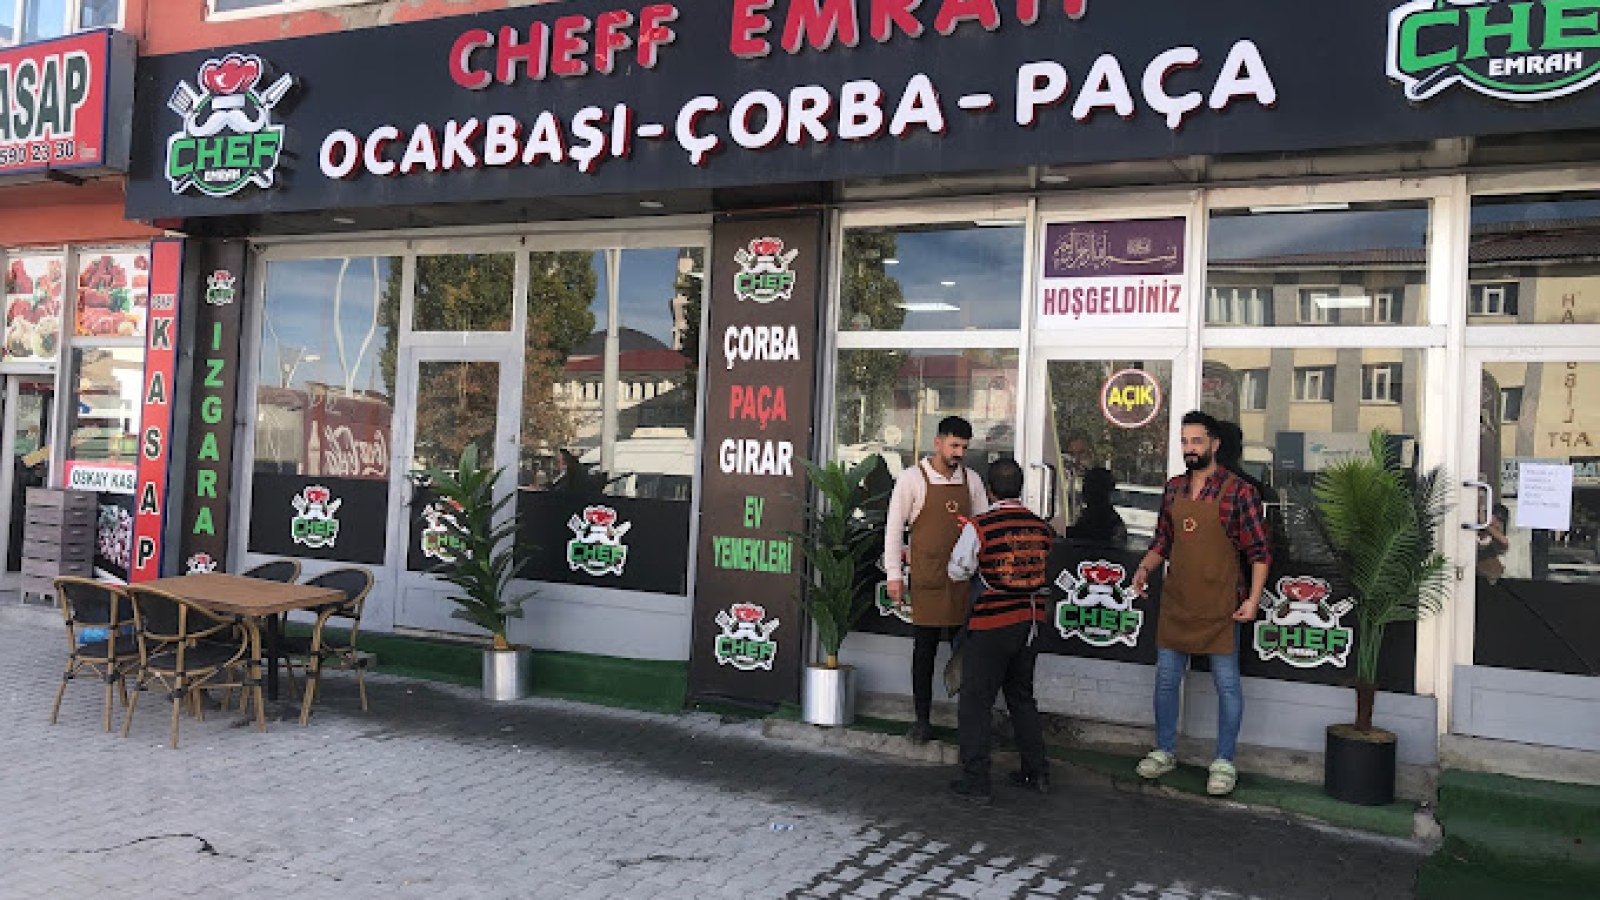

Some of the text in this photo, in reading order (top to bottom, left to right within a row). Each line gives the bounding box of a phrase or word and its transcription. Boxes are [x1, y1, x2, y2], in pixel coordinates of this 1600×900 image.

[449, 4, 679, 90] CHEFF
[1489, 52, 1583, 76] EMRAH
[1015, 39, 1277, 129] PAÇA
[32, 143, 50, 161] 23
[55, 140, 75, 159] 30
[171, 132, 281, 176] CHEF
[738, 272, 793, 291] CHEF
[1042, 279, 1182, 320] HOŞGELDİNİZ
[724, 325, 800, 369] ÇORBA
[729, 384, 787, 430] PAÇA
[1108, 385, 1154, 411] AÇIK
[135, 316, 175, 570] KASAP
[192, 321, 225, 536] IZGARA
[719, 438, 794, 477] GIRAR
[294, 519, 337, 538] CHEF
[743, 495, 765, 529] EV
[571, 542, 624, 563] CHEF
[1061, 604, 1139, 633] CHEF
[718, 636, 774, 658] CHEF
[1259, 624, 1348, 652] CHEF
